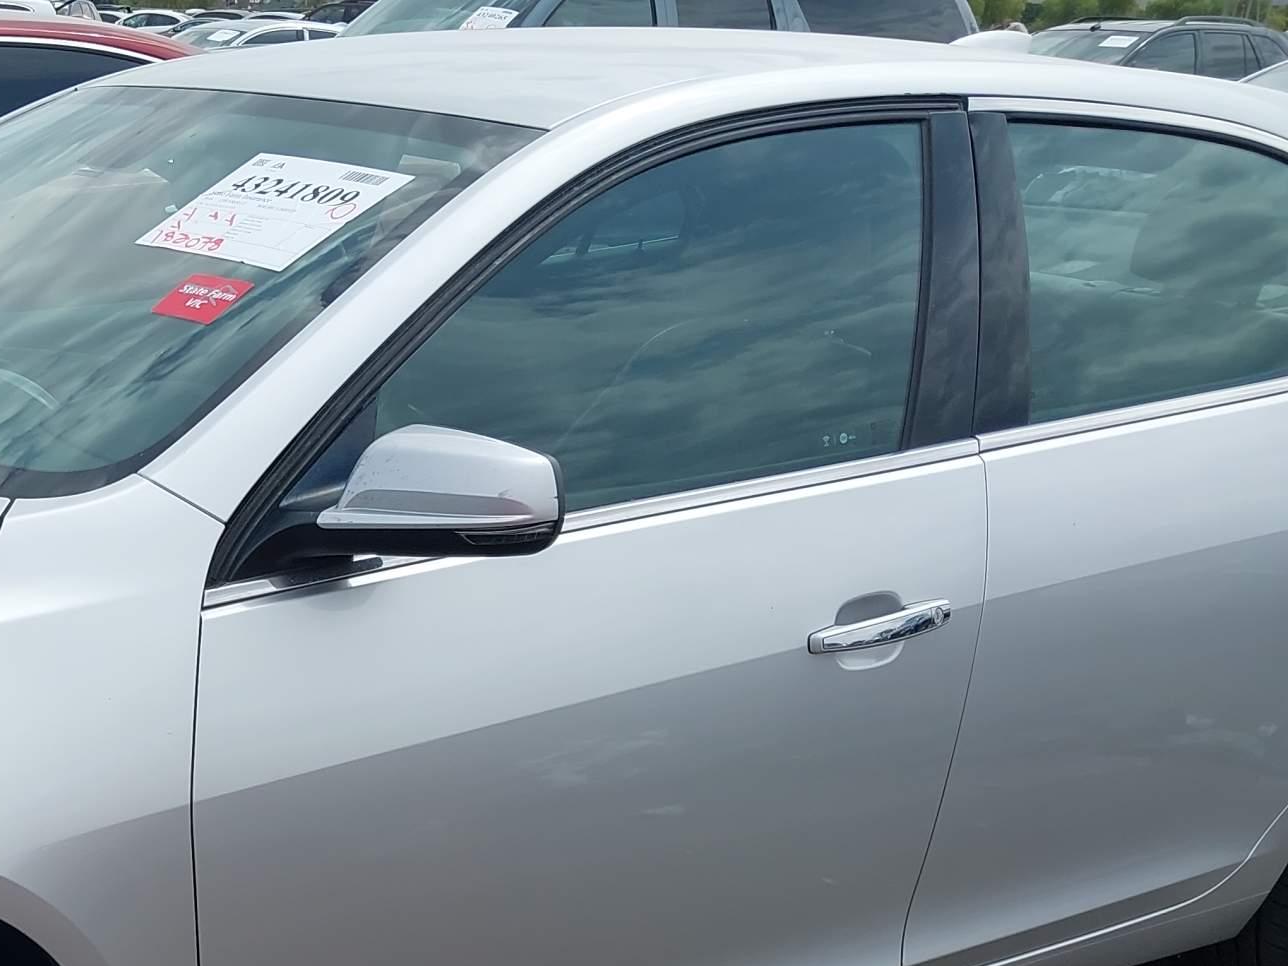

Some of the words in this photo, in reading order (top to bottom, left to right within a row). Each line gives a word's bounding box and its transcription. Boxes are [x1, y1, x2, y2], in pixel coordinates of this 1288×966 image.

[232, 175, 360, 207] 43241809
[178, 284, 209, 297] State
[207, 289, 237, 303] Farm
